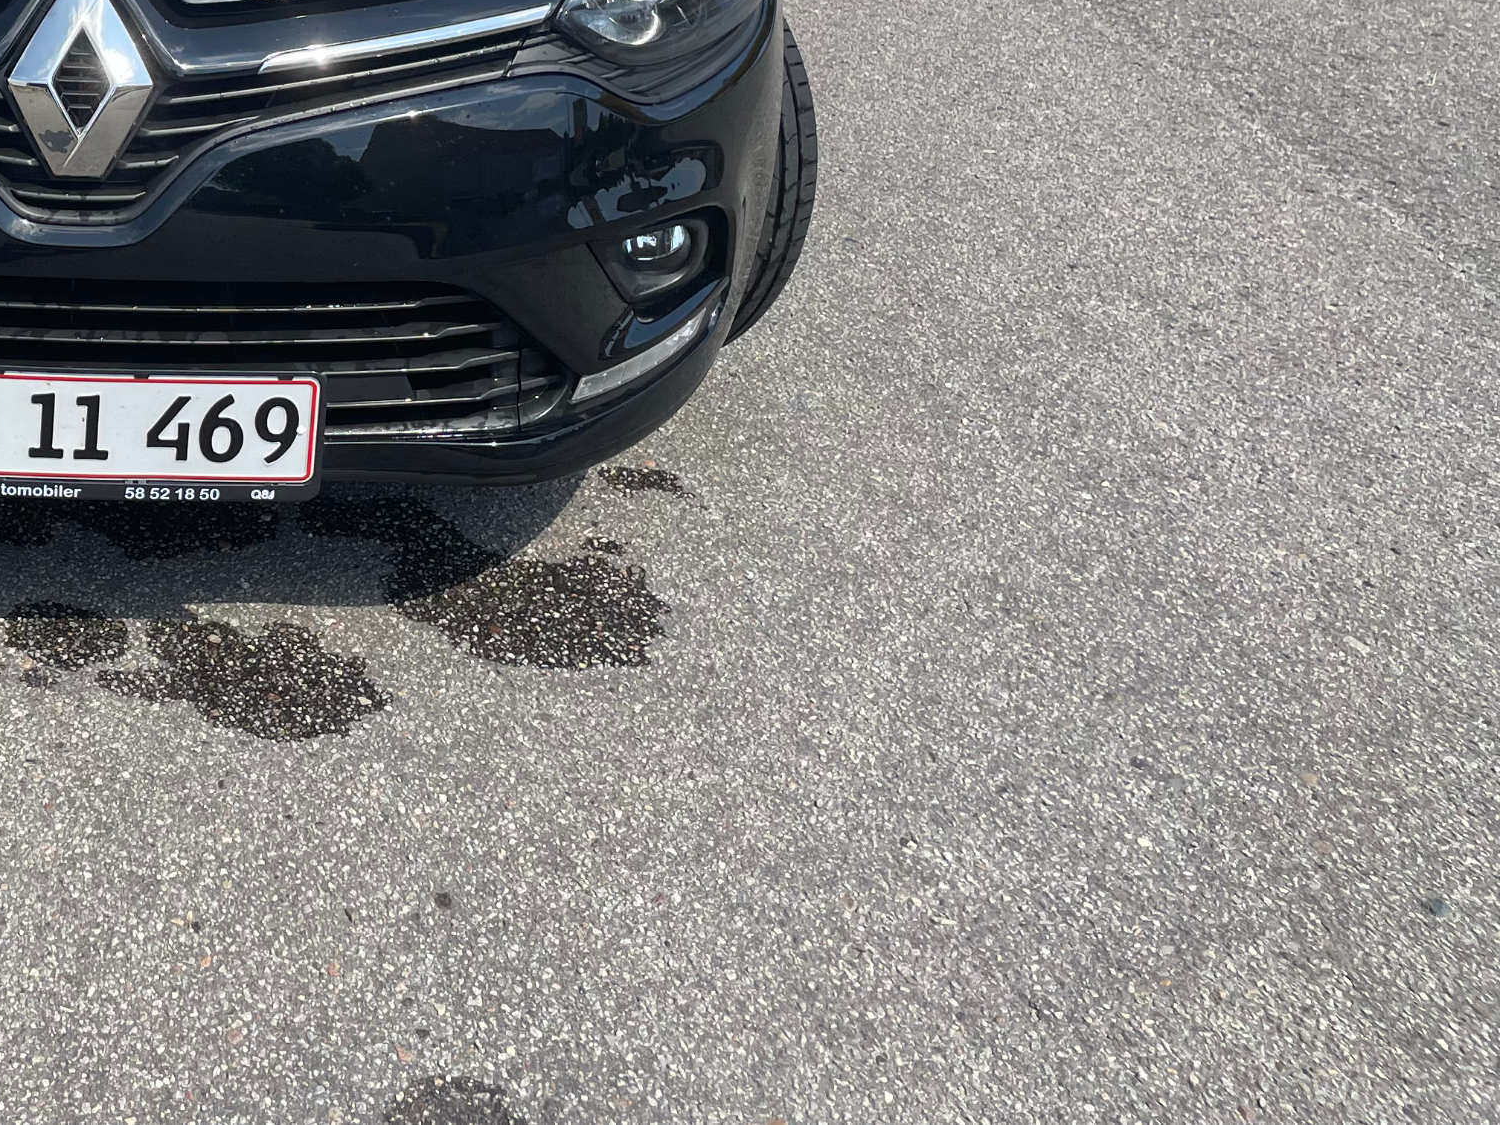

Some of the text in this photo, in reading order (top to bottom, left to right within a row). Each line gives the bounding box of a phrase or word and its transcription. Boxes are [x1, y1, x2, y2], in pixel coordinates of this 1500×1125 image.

[28, 392, 109, 460] 11
[146, 394, 300, 464] 469
[124, 487, 221, 501] 58 52 18 50
